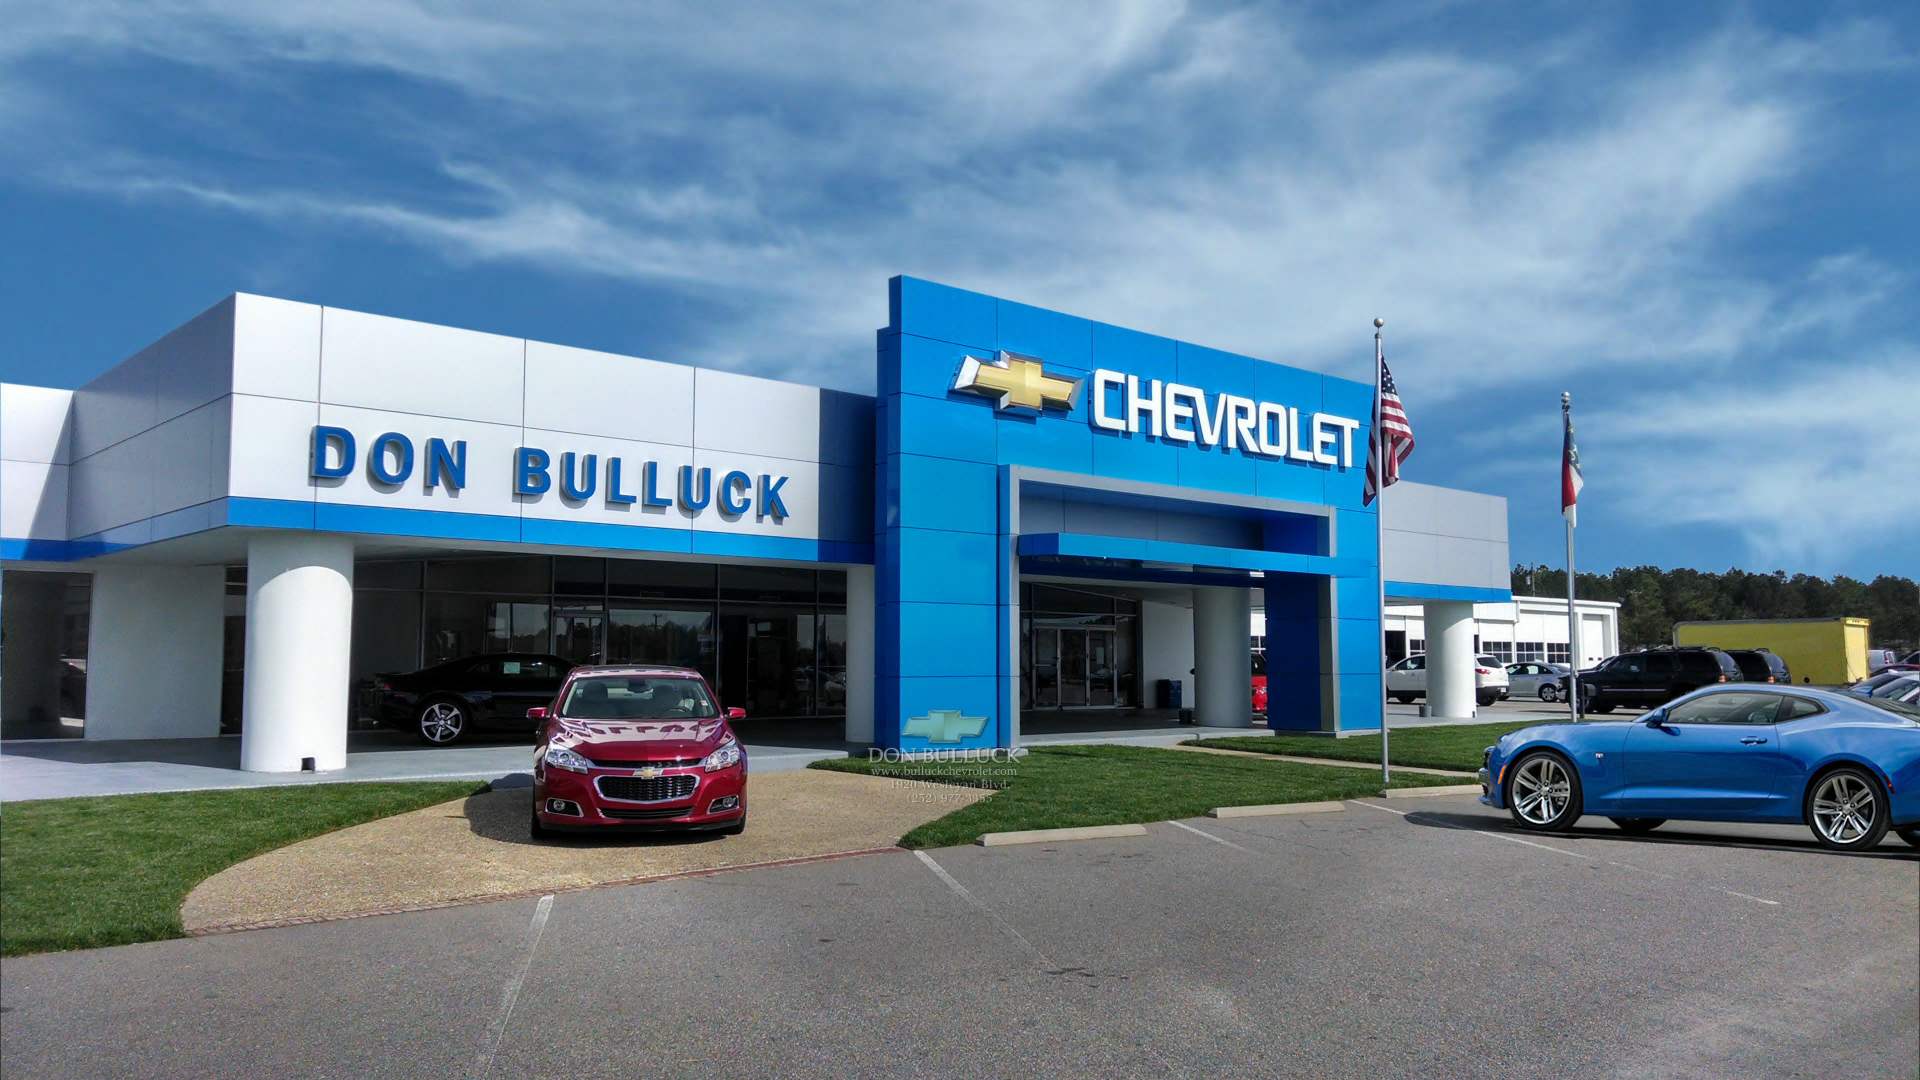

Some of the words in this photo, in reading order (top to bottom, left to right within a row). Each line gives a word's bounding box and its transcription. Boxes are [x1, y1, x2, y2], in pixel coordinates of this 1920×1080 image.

[1092, 368, 1360, 468] CHEVROLET
[313, 425, 467, 489] DON
[515, 447, 790, 518] BULLUCK
